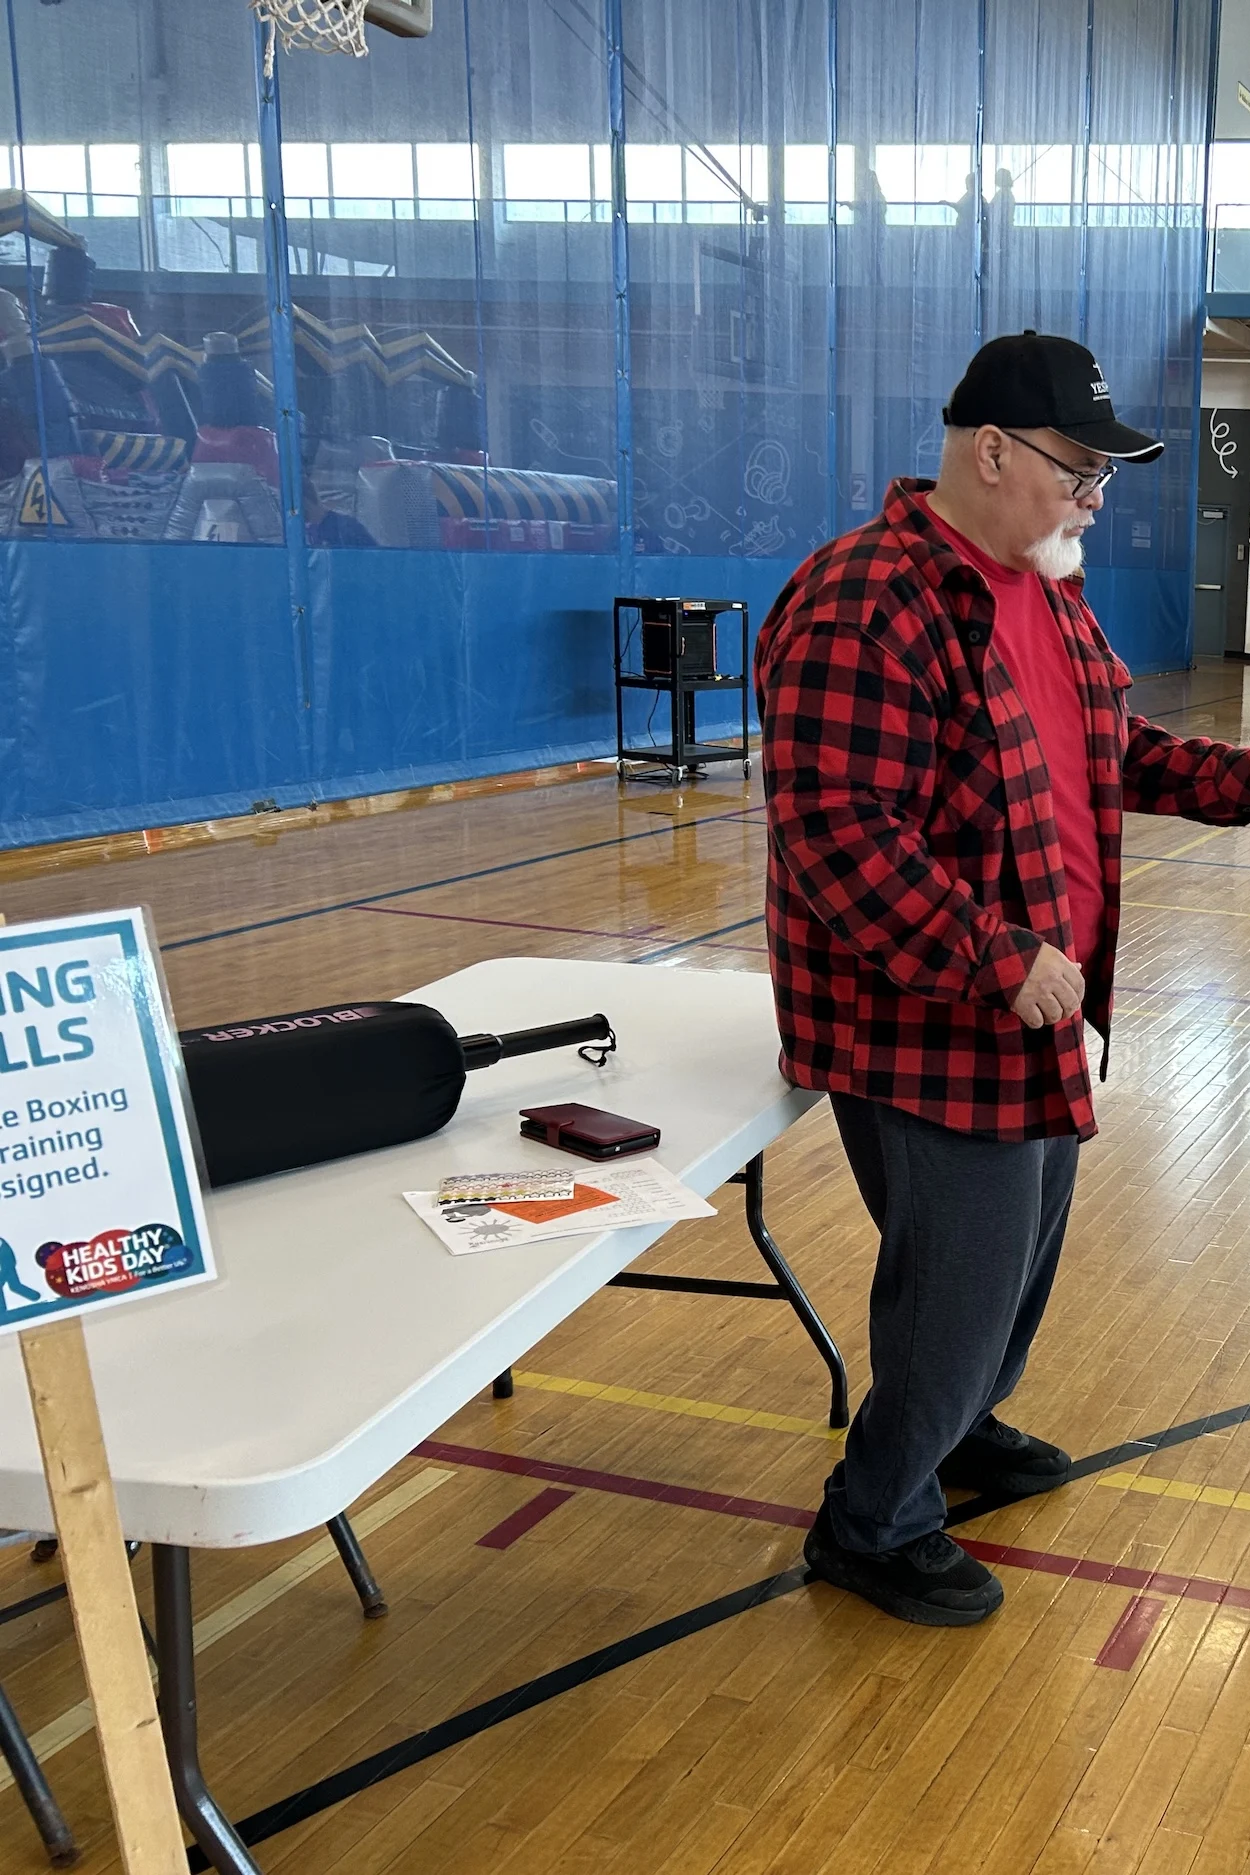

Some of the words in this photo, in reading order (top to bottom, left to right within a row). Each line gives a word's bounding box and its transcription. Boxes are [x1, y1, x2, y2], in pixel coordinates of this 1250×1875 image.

[201, 1009, 364, 1042] BLOCKER
[26, 1087, 128, 1123] Boxing
[62, 1228, 163, 1268] HEALTHY
[65, 1258, 119, 1285] KIDS
[121, 1246, 164, 1271] DAY
[70, 1279, 106, 1294] KENOSHA
[106, 1274, 128, 1286] YMCA
